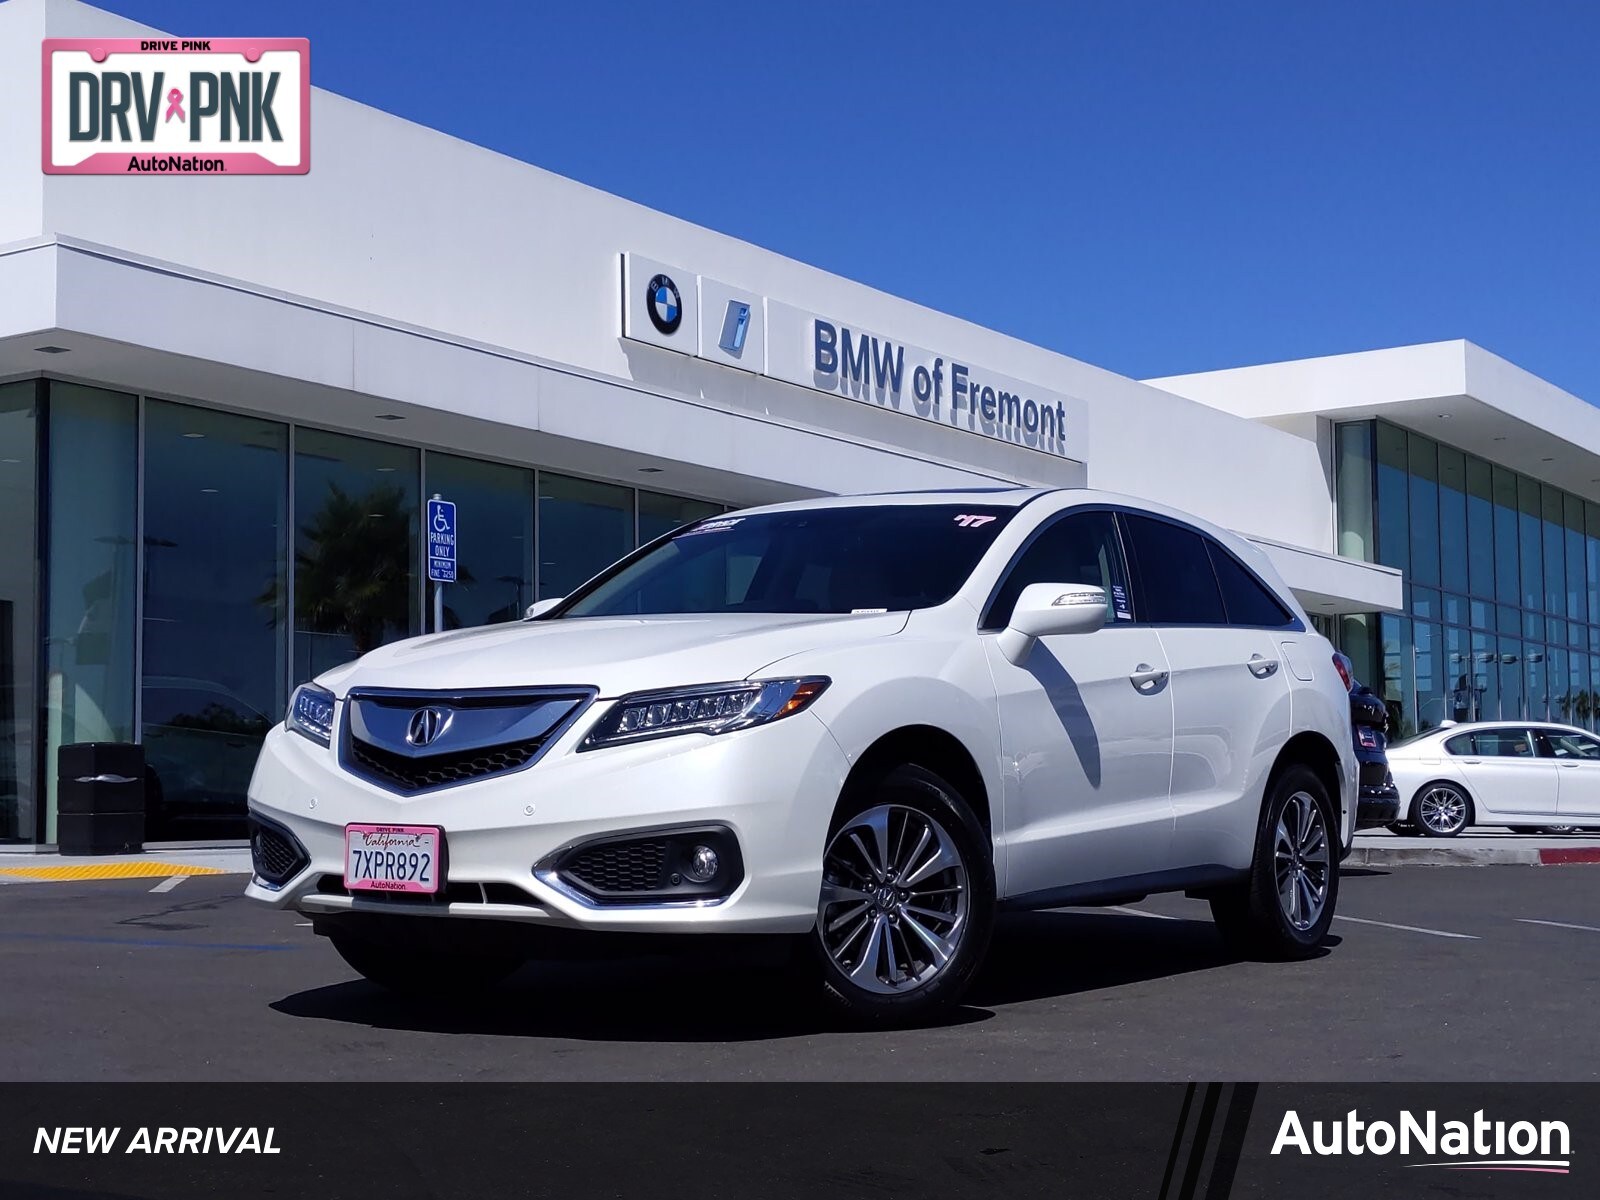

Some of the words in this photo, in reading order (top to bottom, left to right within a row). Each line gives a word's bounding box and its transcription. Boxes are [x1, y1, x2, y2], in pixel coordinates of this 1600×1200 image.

[814, 318, 905, 394] BMW
[912, 357, 943, 402] of
[950, 362, 1066, 442] Fremont
[430, 532, 454, 546] PARKING
[434, 545, 450, 557] ONLY
[364, 833, 421, 851] California
[352, 849, 431, 882] 7XPR892
[370, 881, 406, 891] AutoNation
